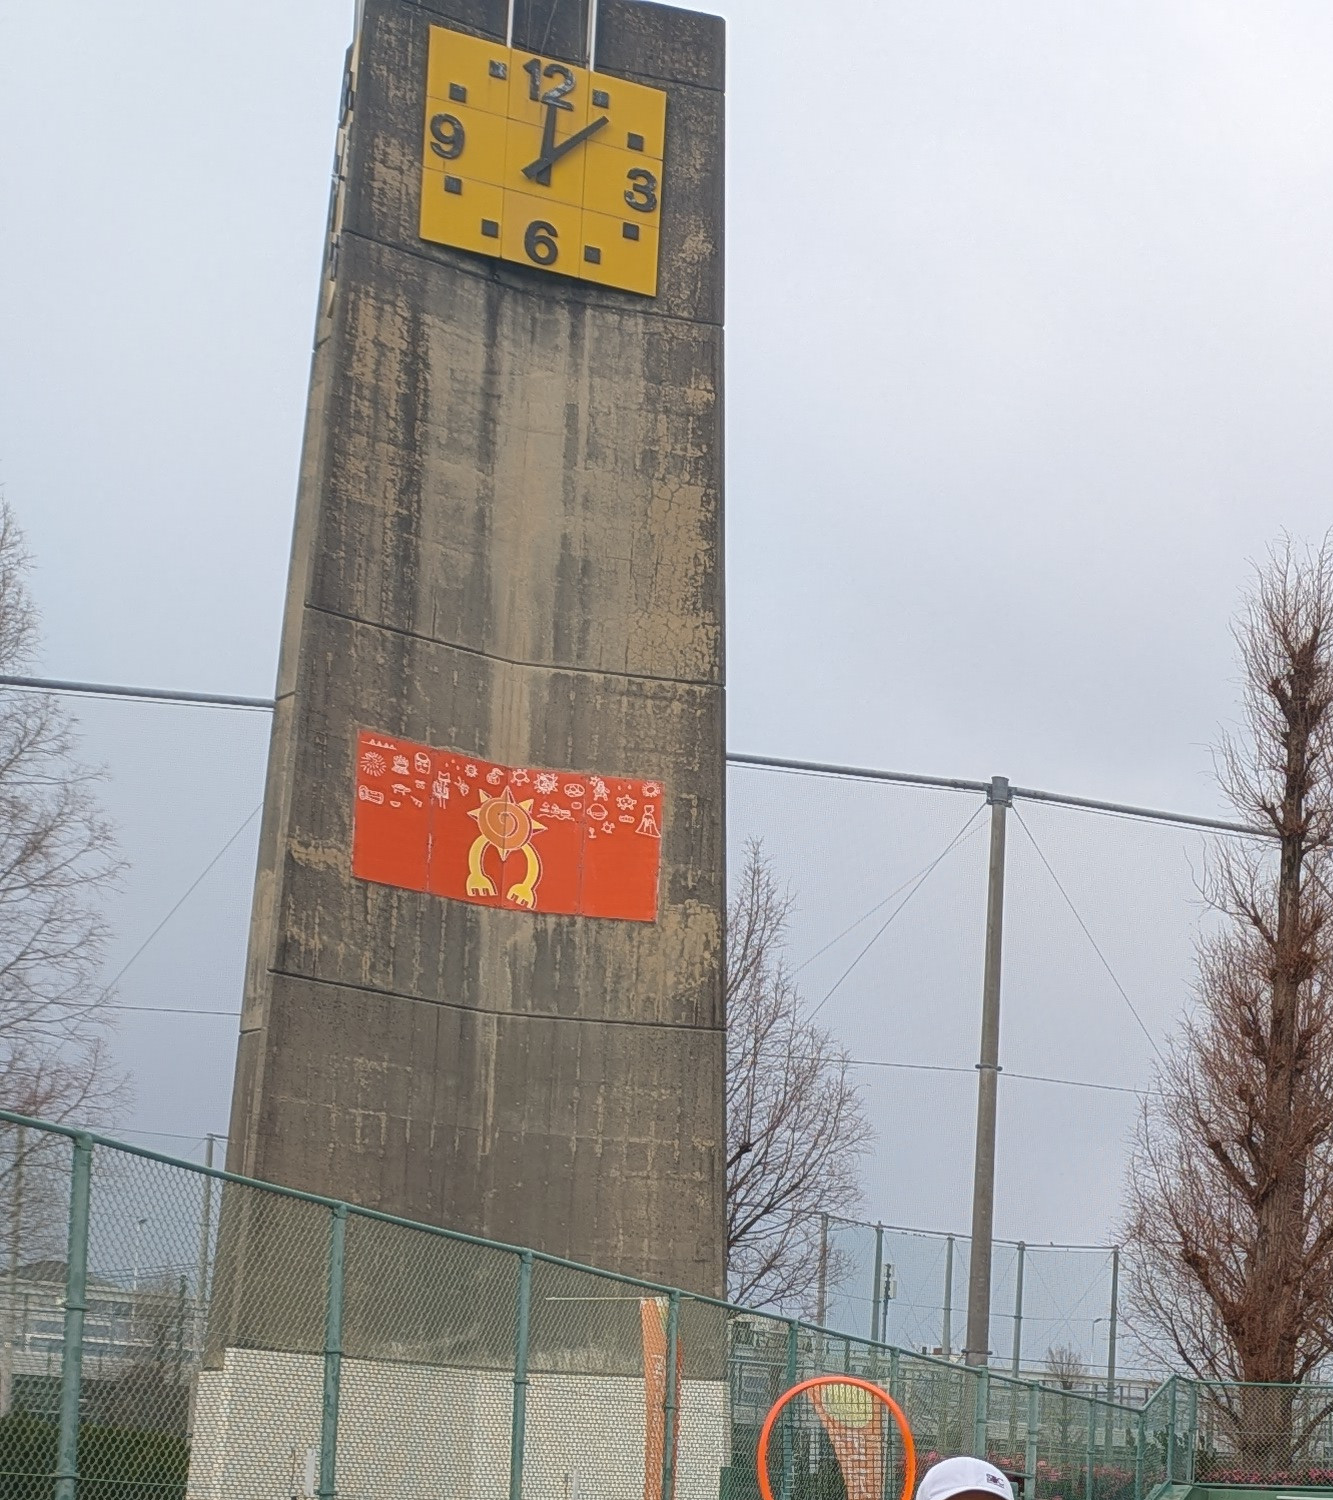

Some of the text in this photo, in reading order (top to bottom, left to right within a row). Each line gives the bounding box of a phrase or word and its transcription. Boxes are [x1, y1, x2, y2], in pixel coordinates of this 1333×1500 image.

[523, 58, 576, 111] 12
[430, 113, 465, 160] 9
[624, 167, 658, 213] 3
[523, 220, 558, 265] 6
